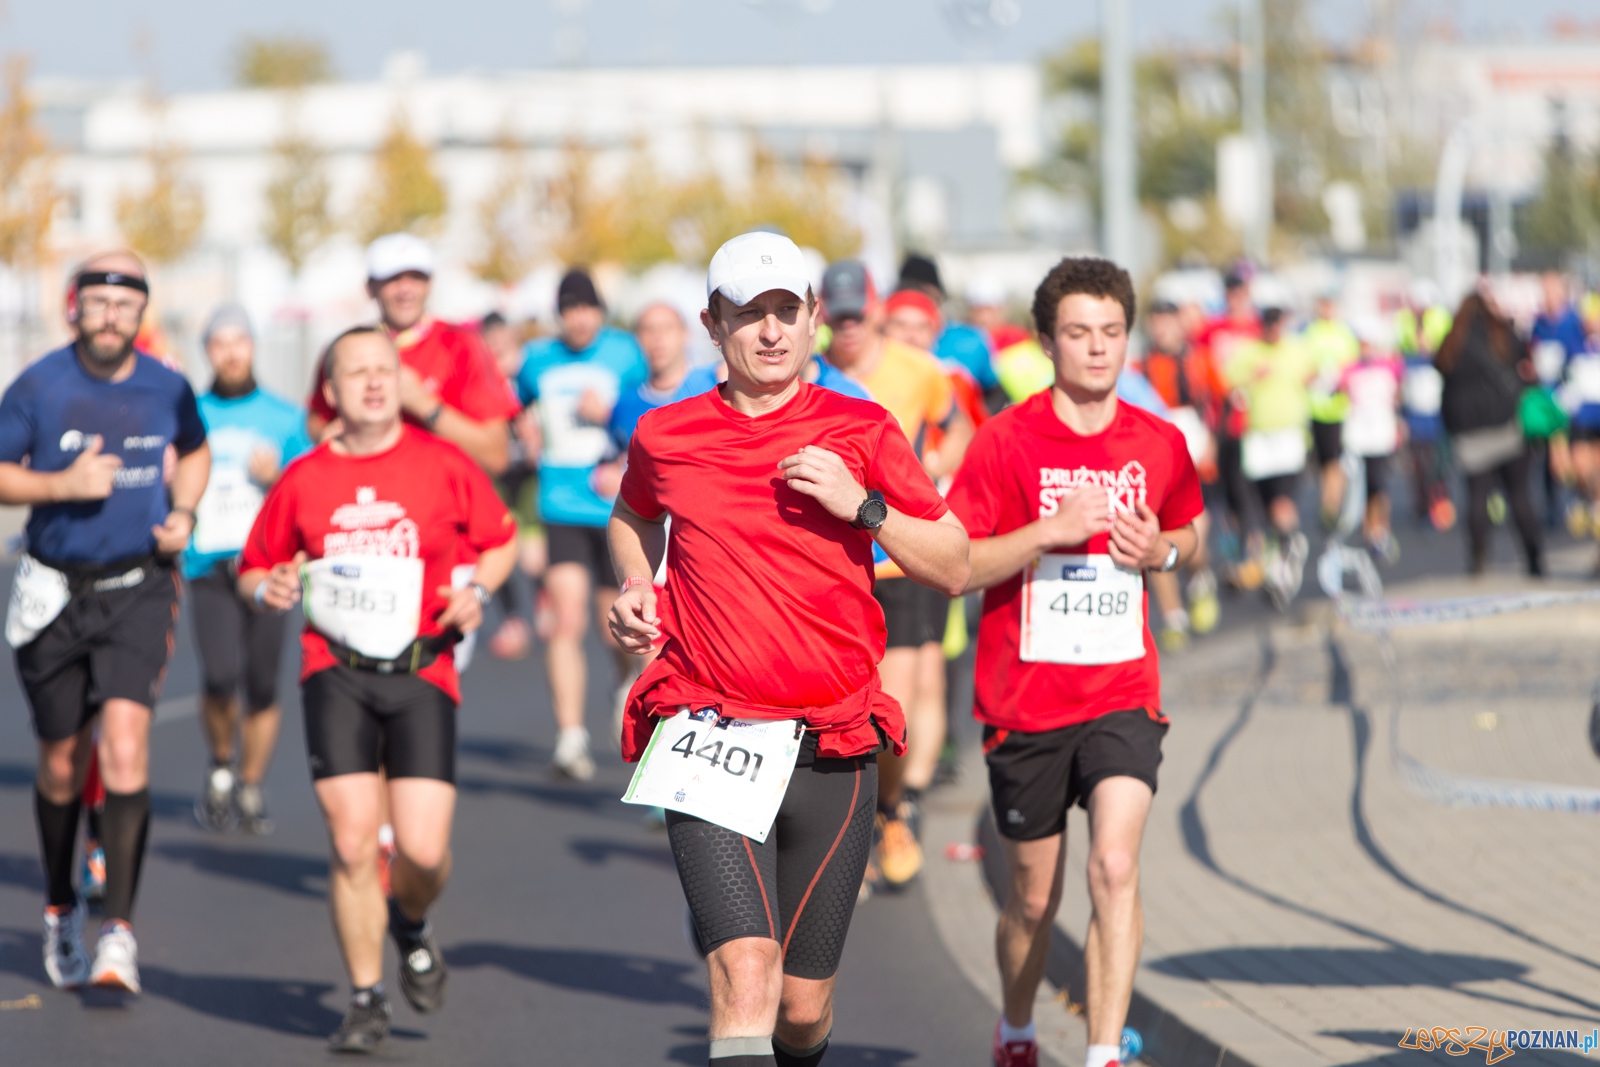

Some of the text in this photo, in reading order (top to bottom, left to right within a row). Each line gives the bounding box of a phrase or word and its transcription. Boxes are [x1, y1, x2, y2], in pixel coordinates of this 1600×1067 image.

[1039, 466, 1131, 488] DRUŻYNA
[325, 586, 396, 614] 3363
[1049, 591, 1129, 616] 4488
[671, 730, 764, 783] 4401
